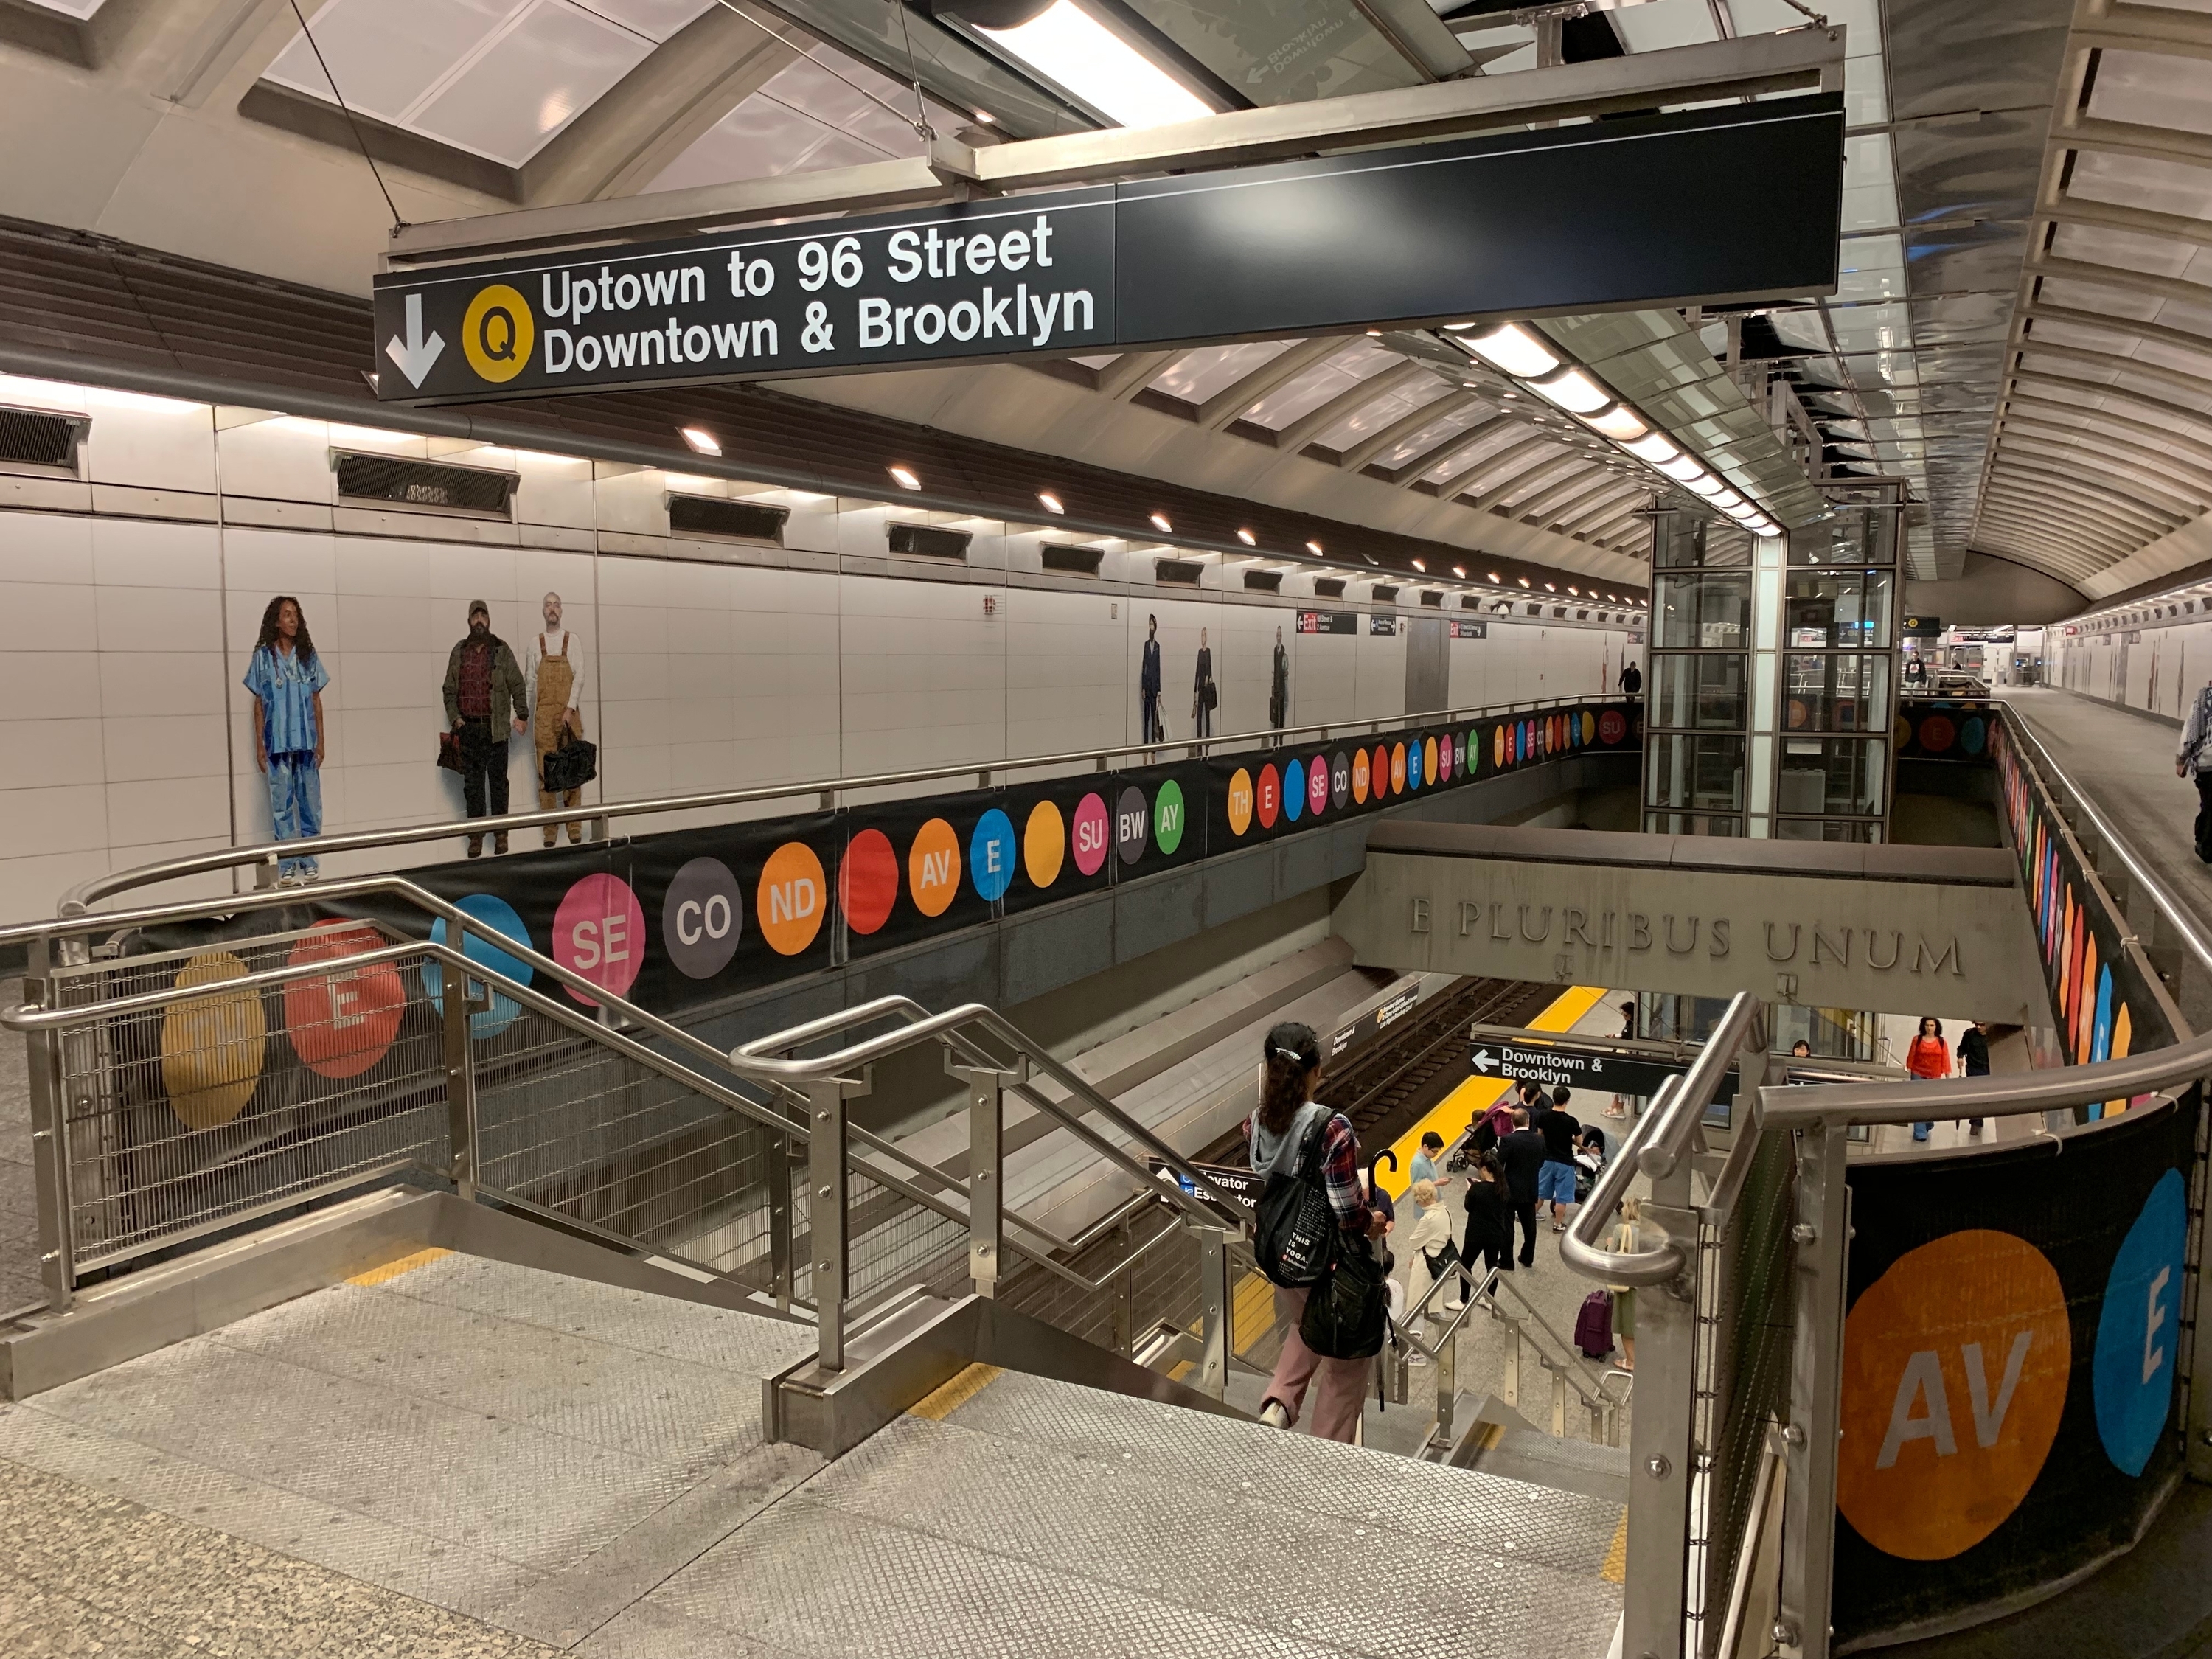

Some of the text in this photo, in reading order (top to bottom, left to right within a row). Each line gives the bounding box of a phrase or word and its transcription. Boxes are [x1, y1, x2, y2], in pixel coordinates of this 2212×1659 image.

[543, 215, 1053, 325] Uptown to 96 Street
[479, 306, 516, 361] Q
[544, 283, 1093, 374] Downtown & Brooklyn
[1303, 614, 1316, 630] Exit
[1603, 722, 1621, 734] SU
[1233, 744, 1477, 815] TH E SE CO ND AV E SU BW AY
[326, 969, 364, 1030] E
[572, 914, 630, 970] SE
[676, 894, 731, 945] CO
[770, 878, 815, 924] ND
[920, 849, 950, 889] AV
[987, 839, 1001, 873] E
[1079, 818, 1103, 852] SU
[1120, 811, 1145, 843] BW
[1161, 804, 1179, 833] AY
[1411, 898, 1964, 975] E PLURIBUS UNUM
[1502, 1048, 1603, 1072] Downtown &
[1502, 1063, 1571, 1085] Brooklyn
[1286, 1246, 1308, 1264] YOGA.
[1288, 1239, 1296, 1248] IS
[1292, 1231, 1310, 1246] THIS
[1874, 1265, 2171, 1470] AV E
